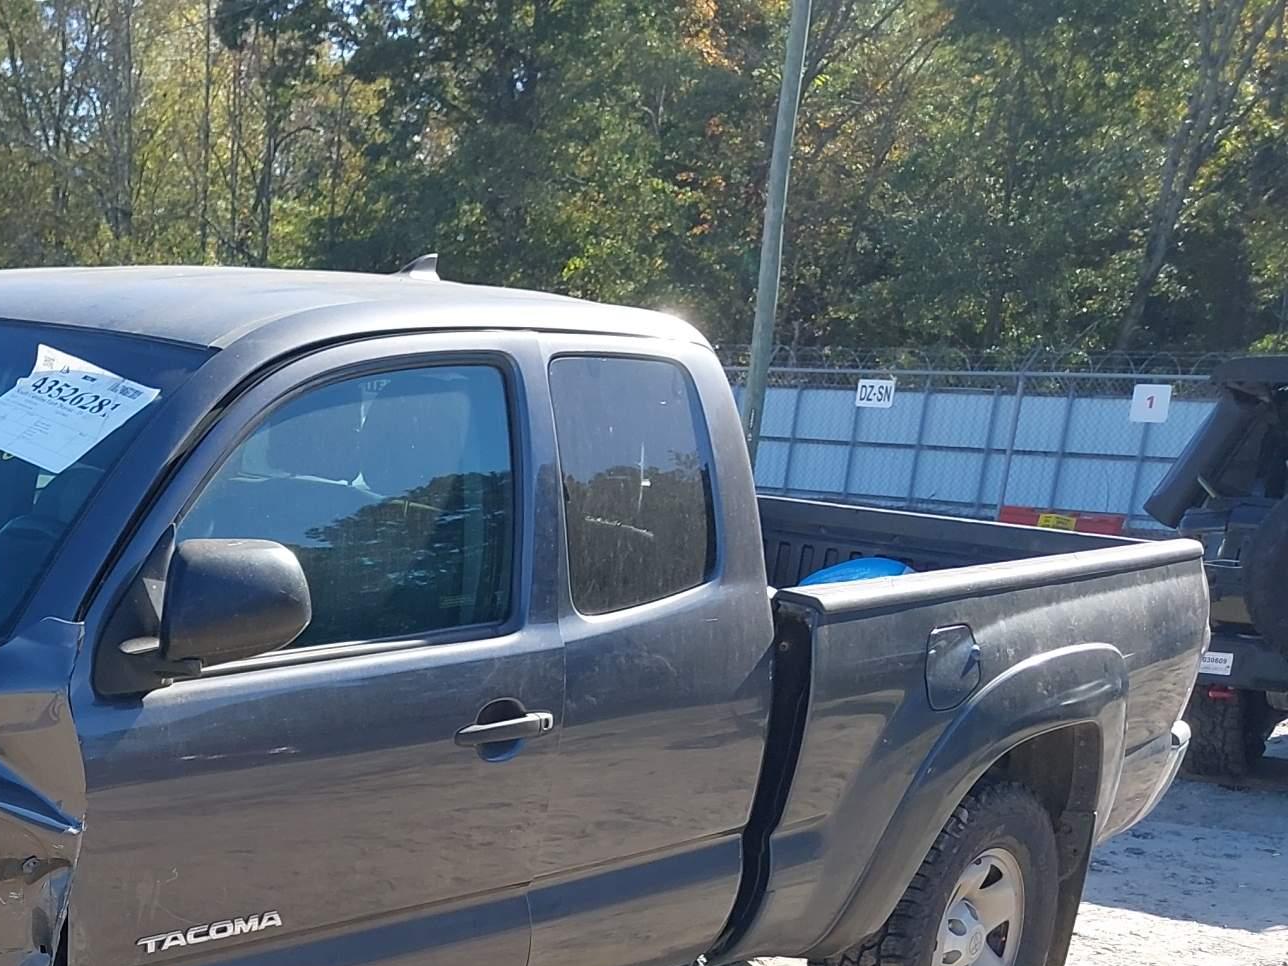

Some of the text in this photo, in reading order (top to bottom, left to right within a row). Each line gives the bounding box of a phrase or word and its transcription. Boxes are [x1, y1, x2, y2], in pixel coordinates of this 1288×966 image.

[31, 376, 121, 418] 43526281
[1146, 395, 1155, 409] 1
[136, 910, 283, 954] TACOMA
